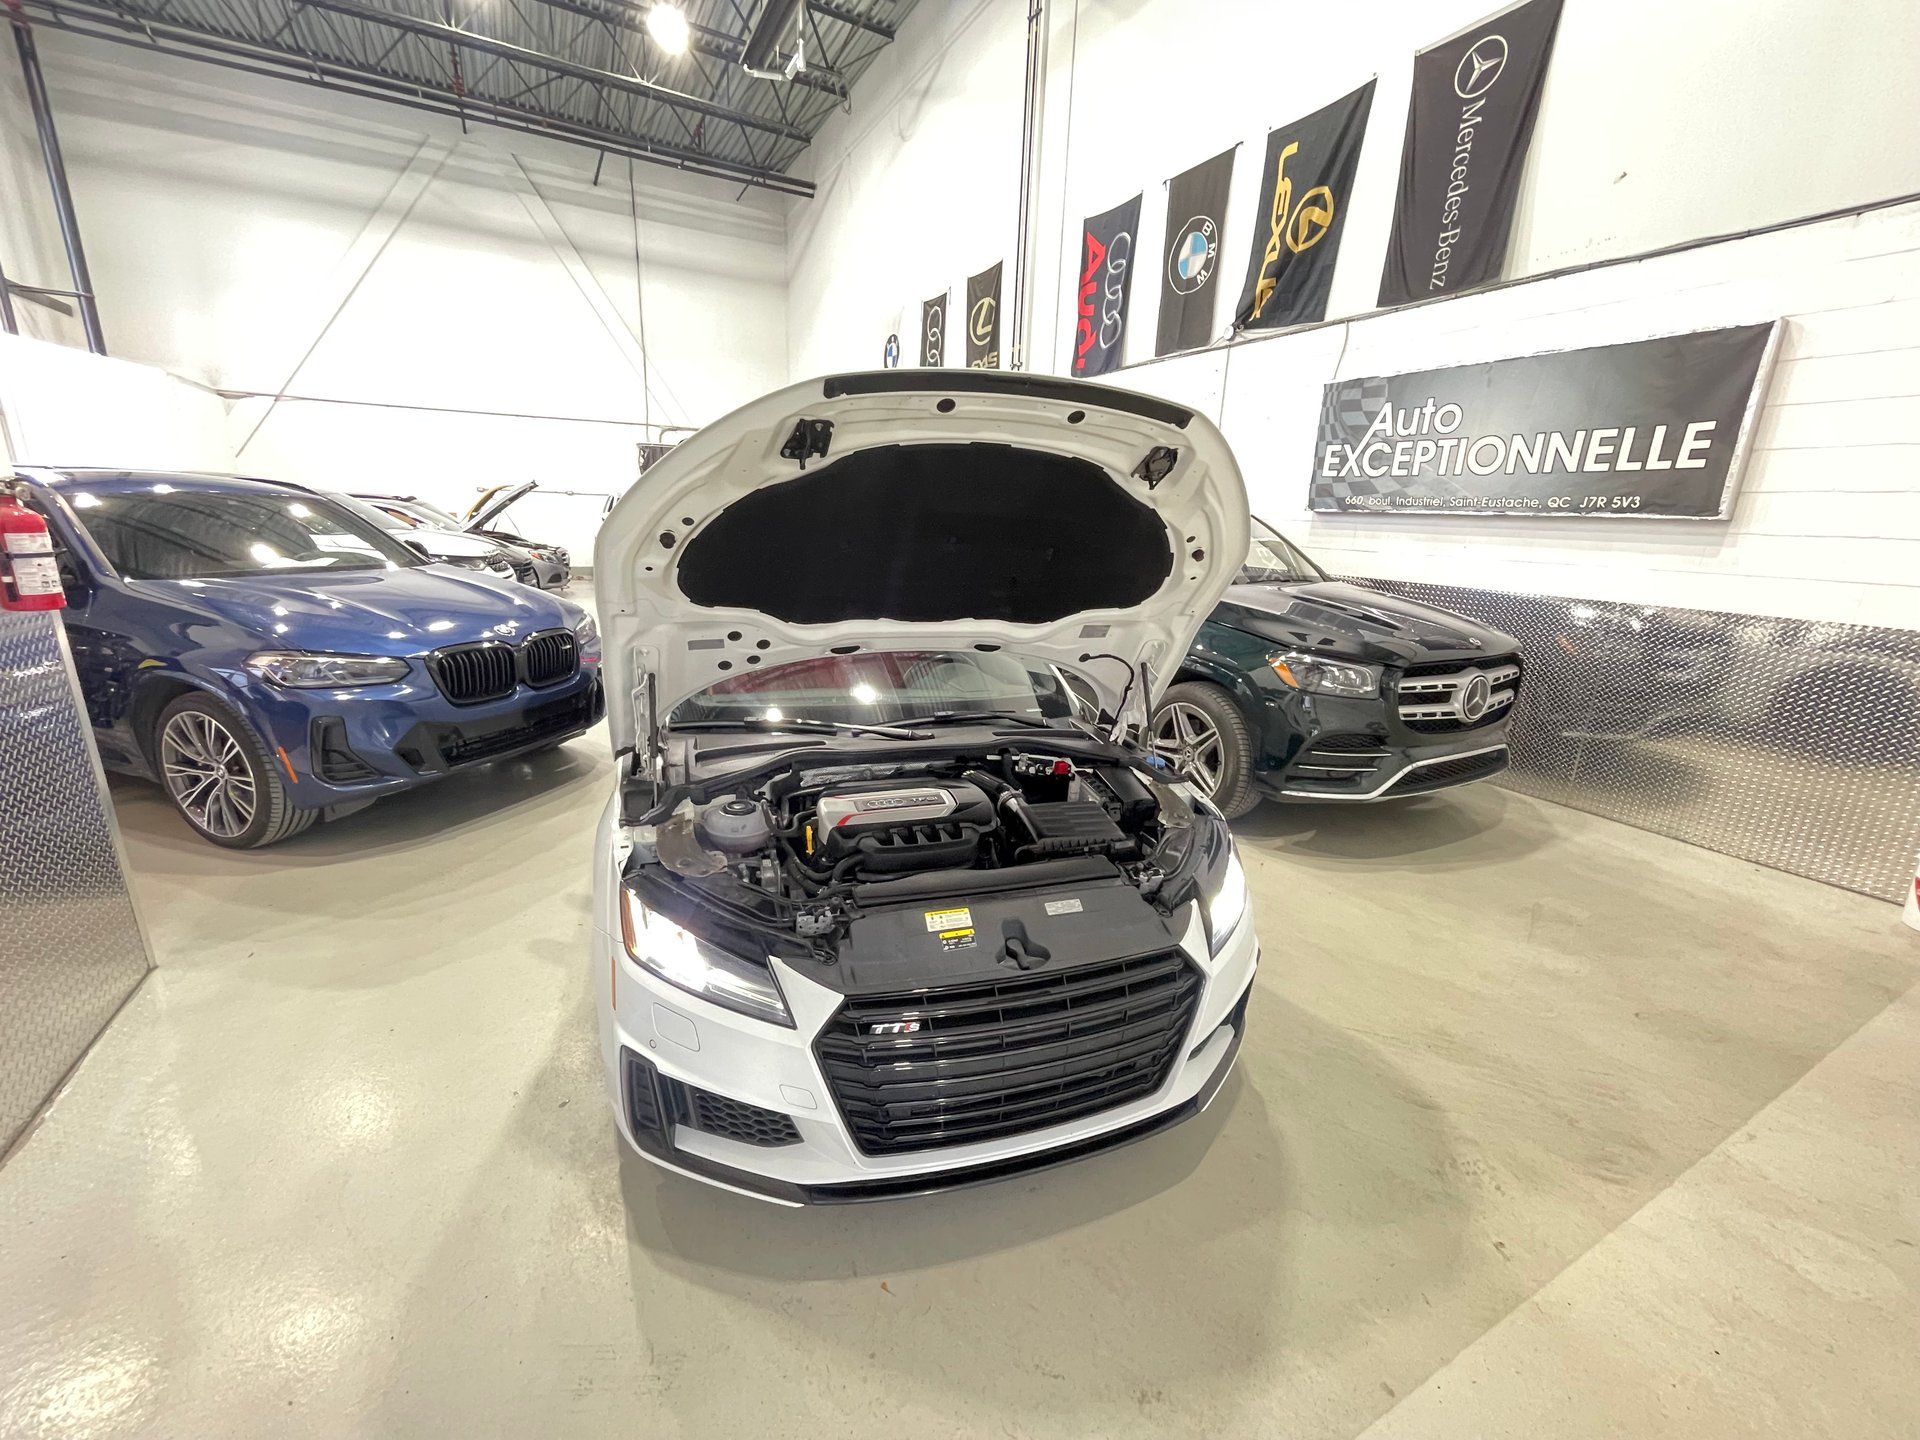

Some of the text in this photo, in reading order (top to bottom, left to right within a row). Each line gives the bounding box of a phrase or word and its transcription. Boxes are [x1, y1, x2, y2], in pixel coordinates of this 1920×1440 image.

[1430, 97, 1486, 290] Mercedes-Benz
[1361, 396, 1464, 438] Auto
[1322, 420, 1717, 478] EXCEPTIONNELLE
[1396, 496, 1446, 507] Industriel,
[1449, 496, 1542, 509] Saint-Eustache,
[1547, 496, 1571, 508] QC
[1579, 496, 1606, 508] J7R
[1611, 496, 1641, 508] 5V3
[871, 1022, 920, 1034] TTS
